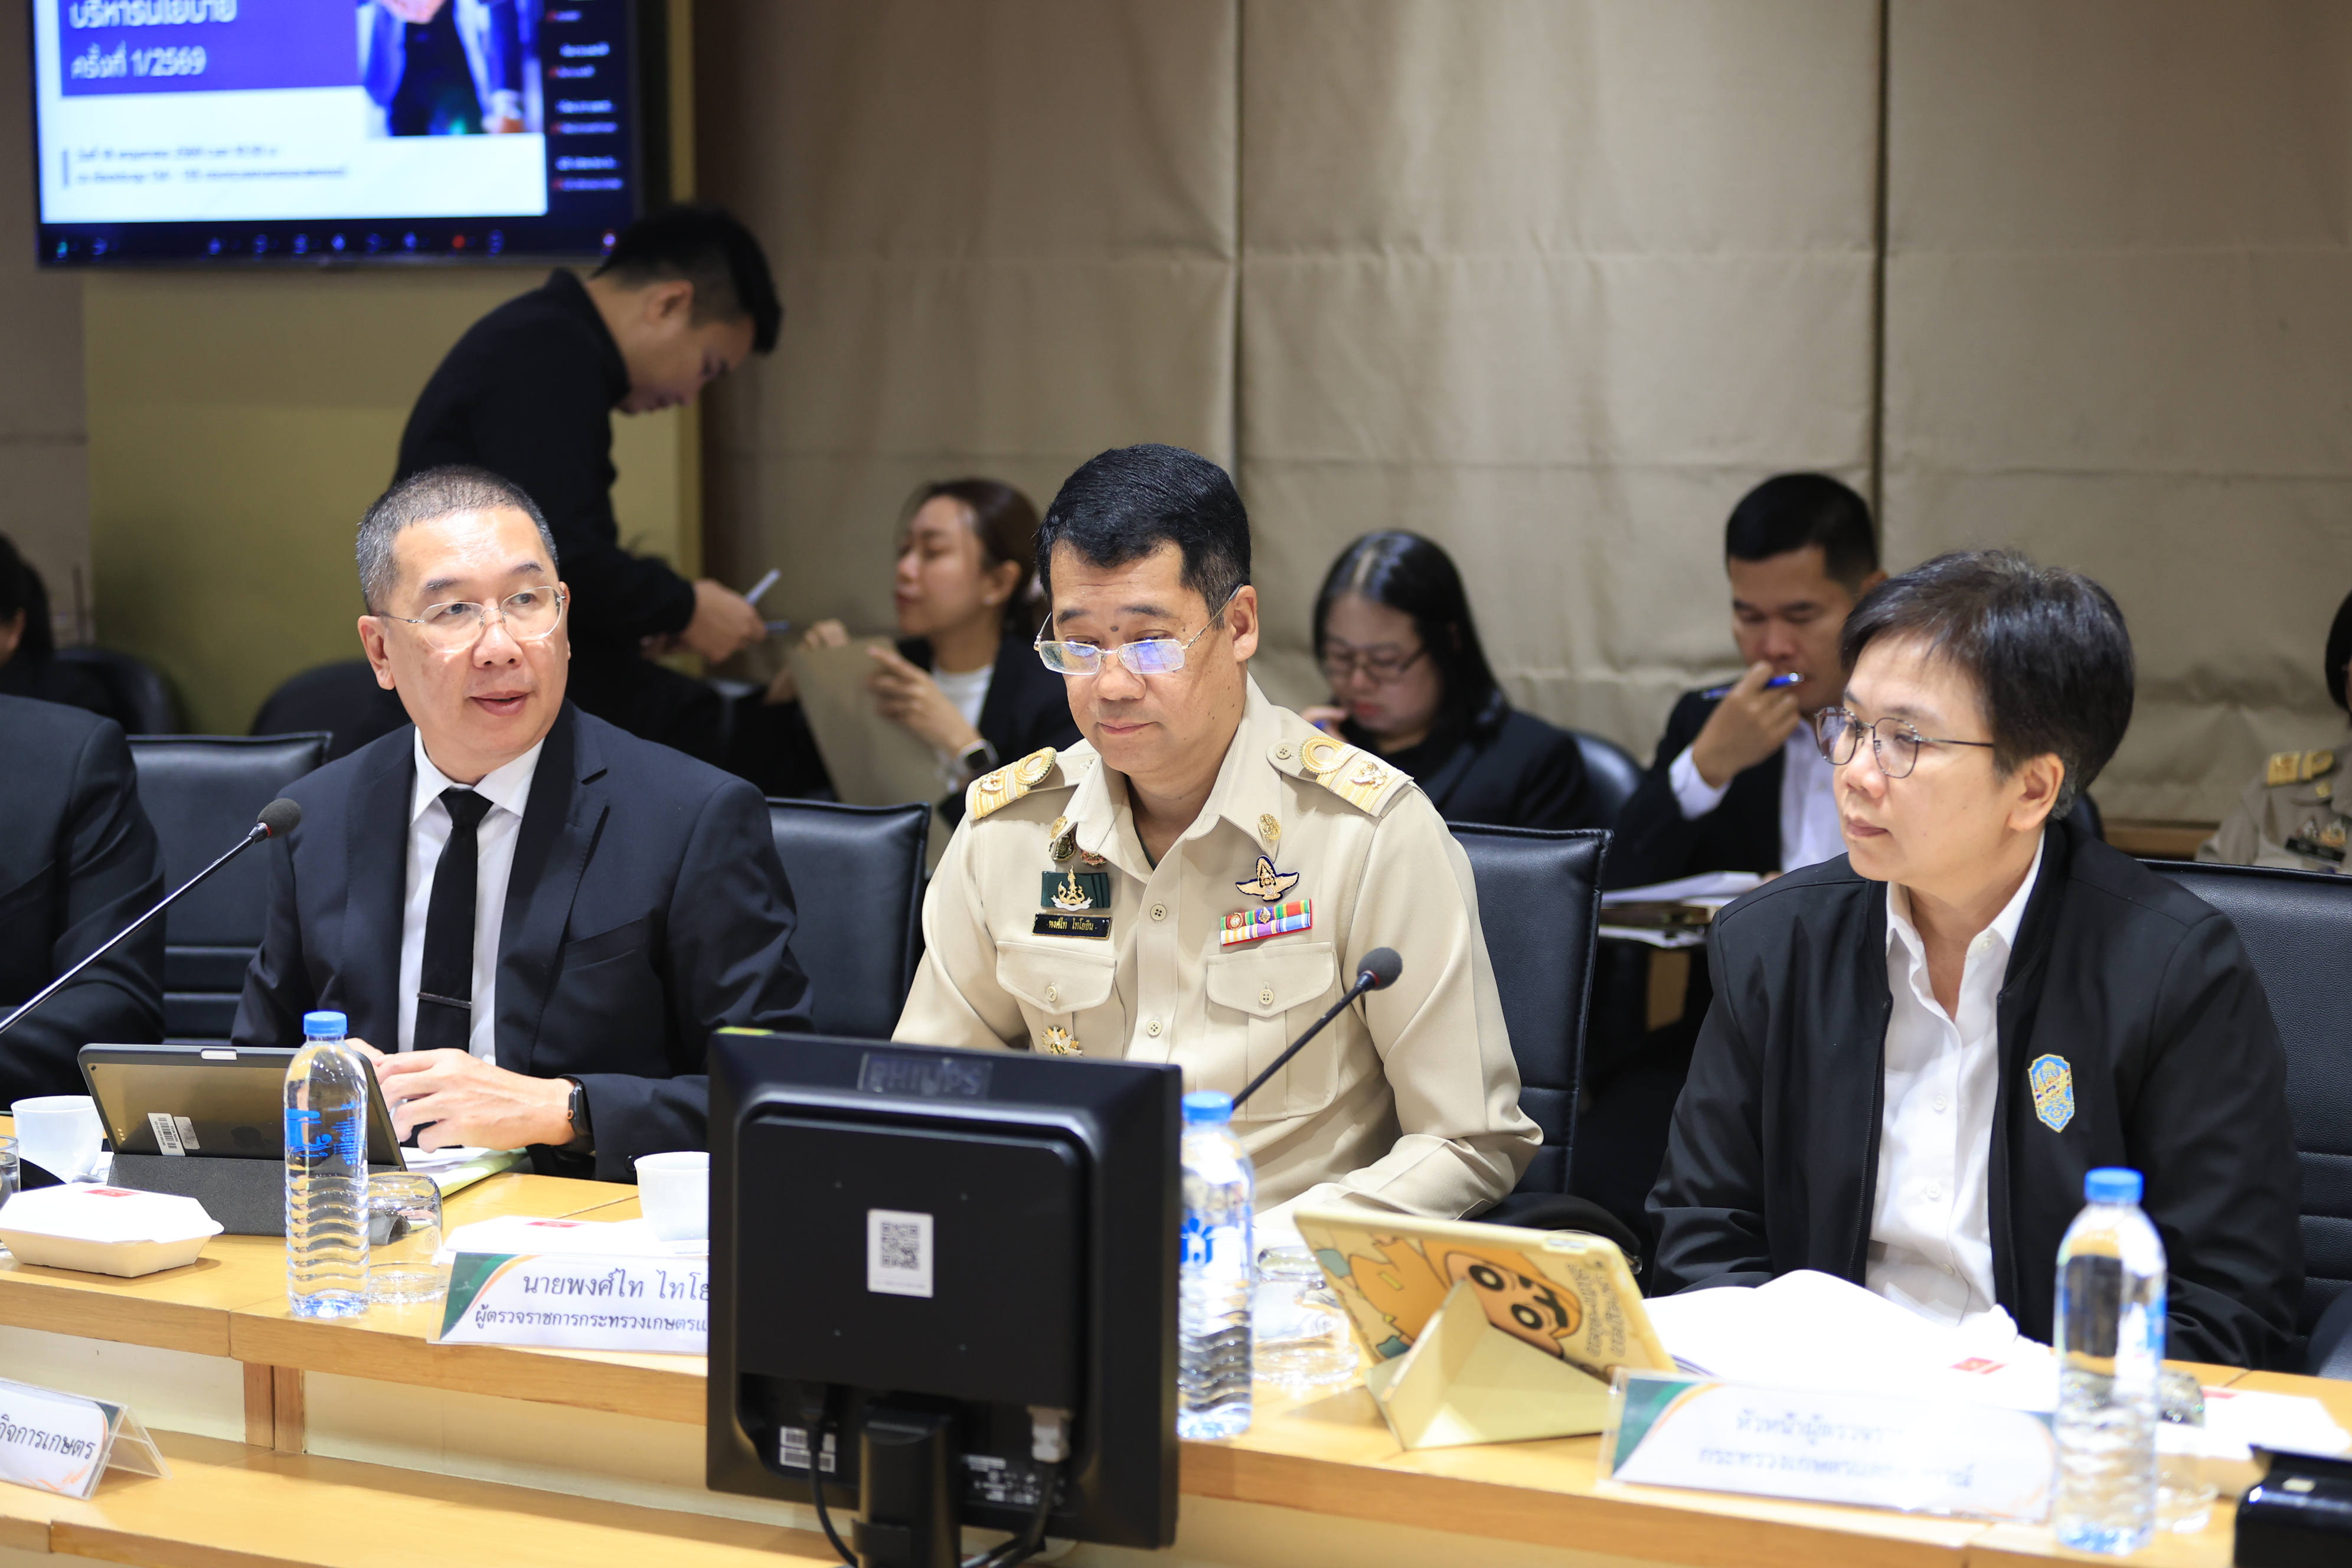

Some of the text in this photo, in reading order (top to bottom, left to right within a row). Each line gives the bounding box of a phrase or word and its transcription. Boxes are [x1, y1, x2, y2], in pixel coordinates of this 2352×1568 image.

[130, 45, 207, 77] 1/2569
[1048, 917, 1094, 931] พงศ์ไท ไทโยธิน
[523, 1268, 644, 1298] นายพงศ์ไท
